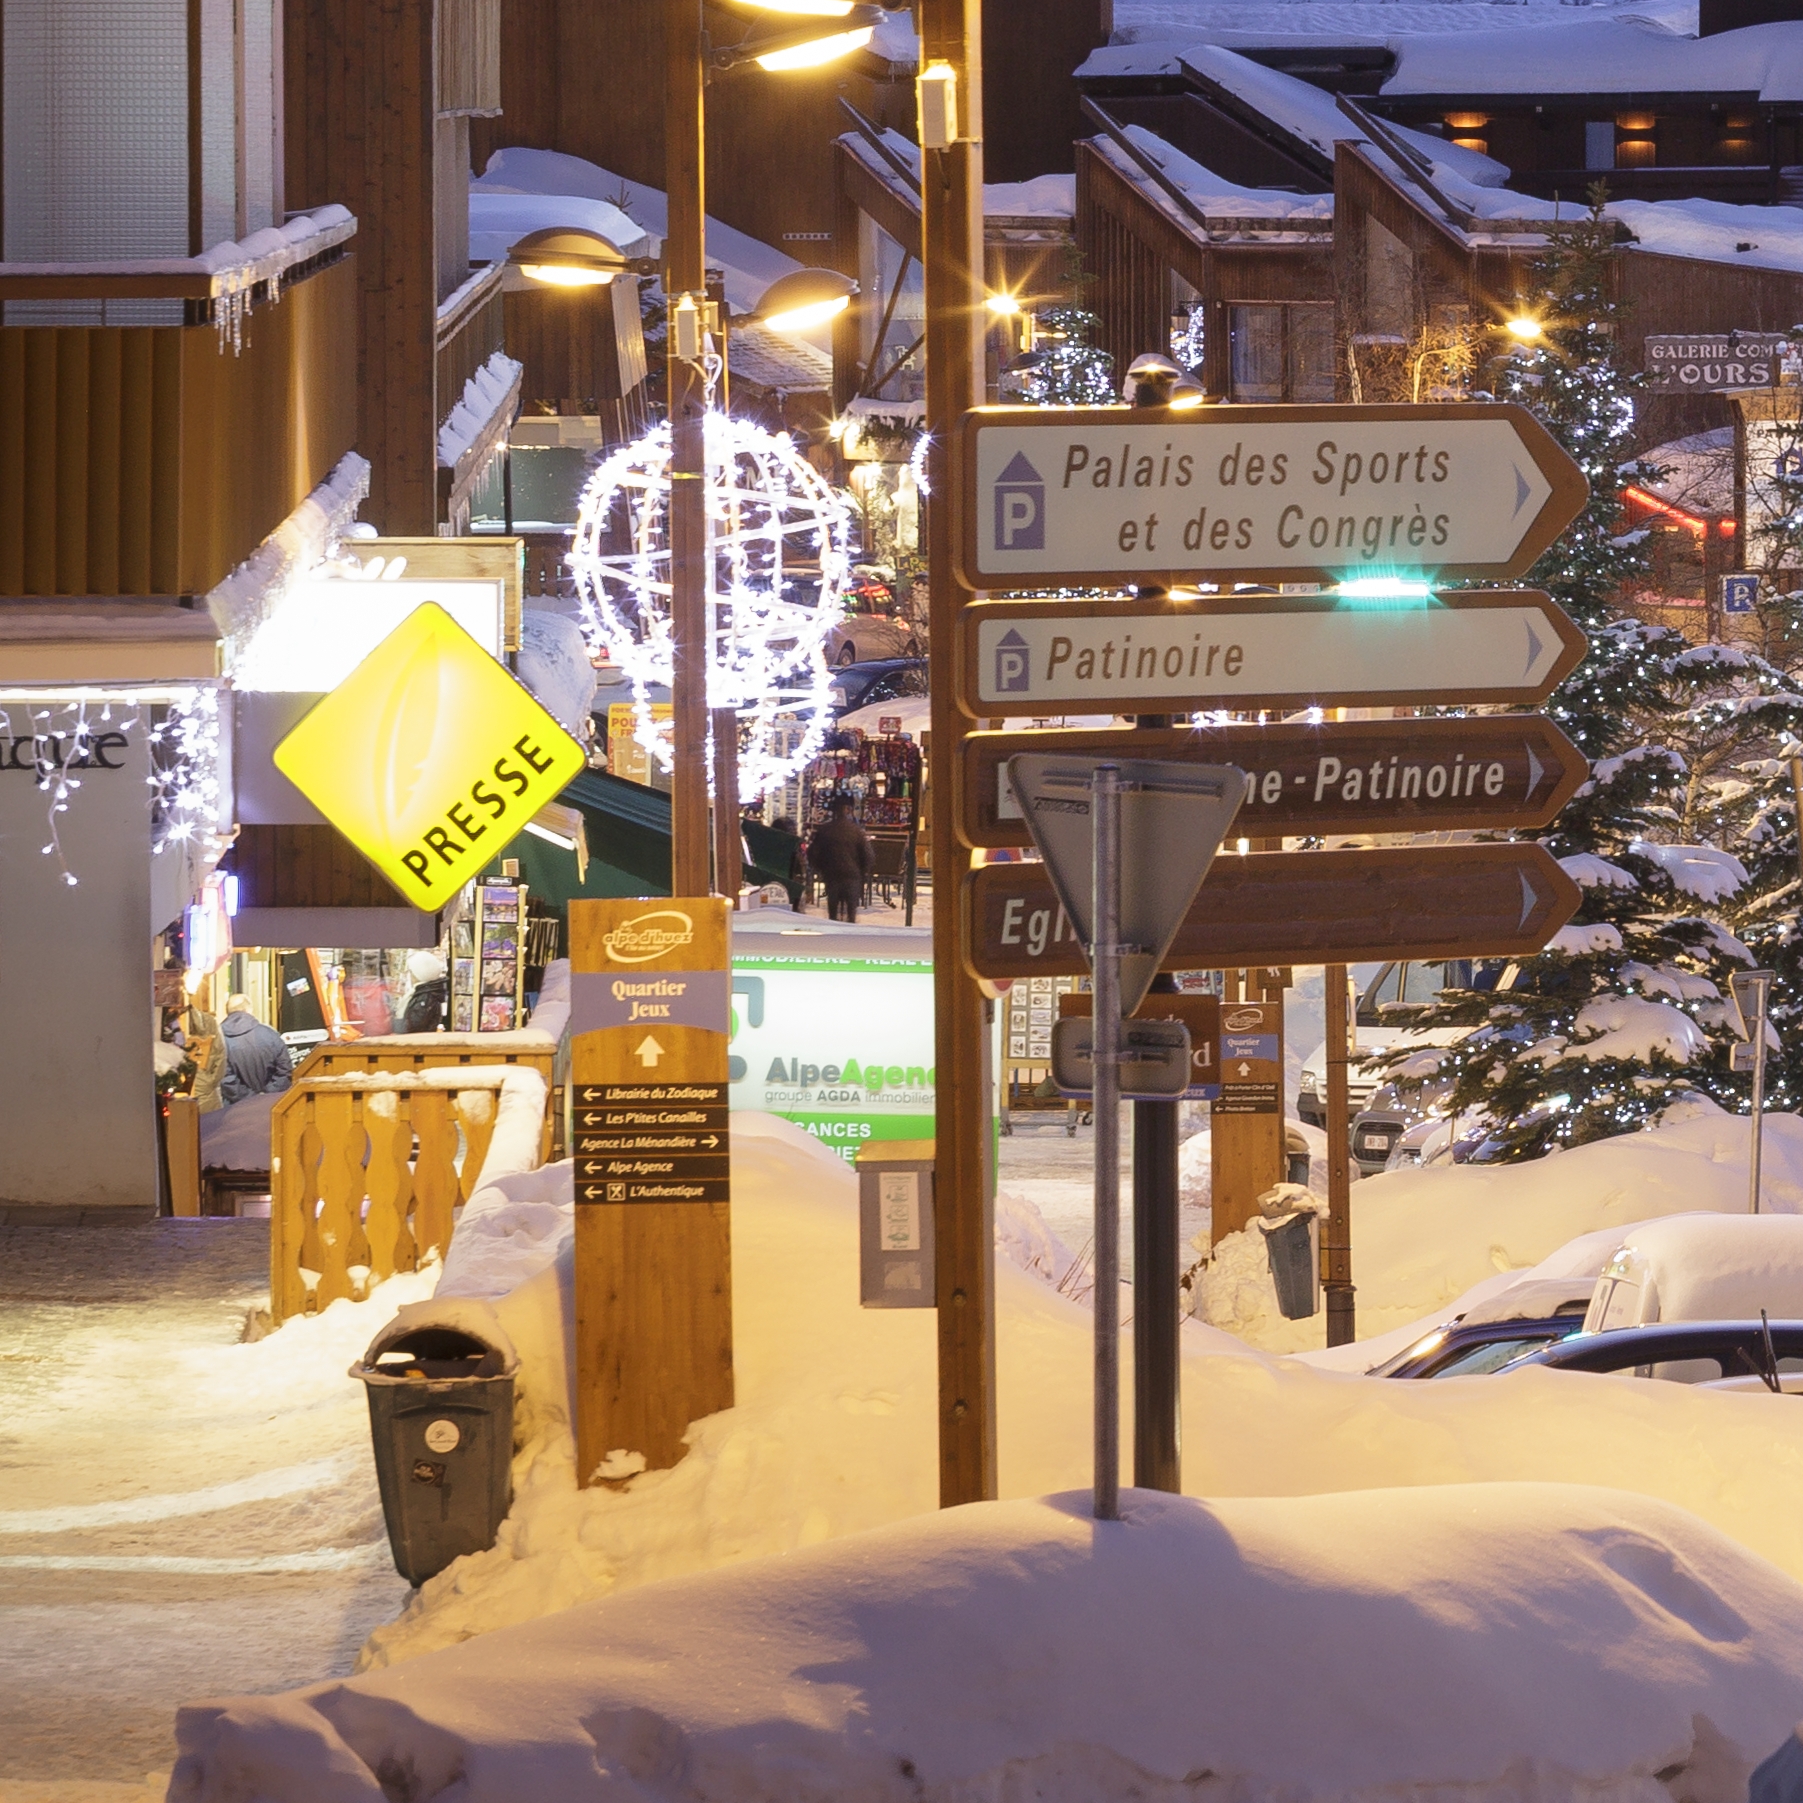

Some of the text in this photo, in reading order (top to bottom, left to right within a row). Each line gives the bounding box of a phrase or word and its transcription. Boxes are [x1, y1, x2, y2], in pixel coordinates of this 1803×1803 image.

[1651, 345, 1729, 359] GALERIE
[1651, 363, 1770, 385] L'OURS
[1062, 440, 1451, 496] Palais des Sports
[1118, 503, 1451, 560] et des Congrès
[1046, 633, 1245, 681] Patinoire
[0, 732, 128, 784] que
[401, 734, 554, 887] PRESSE
[612, 979, 687, 1001] Quartier
[628, 1001, 670, 1021] Jeux
[606, 1087, 718, 1100] Librairie du Zodiaque
[765, 1091, 812, 1103] groupe
[817, 1090, 860, 1102] AGDA
[606, 1113, 624, 1124] Les
[658, 1111, 707, 1123] Canailles
[580, 1138, 619, 1151] Agence
[621, 1137, 633, 1148] La
[607, 1161, 674, 1175] Alpe Agence
[630, 1185, 705, 1198] L'Authentique
